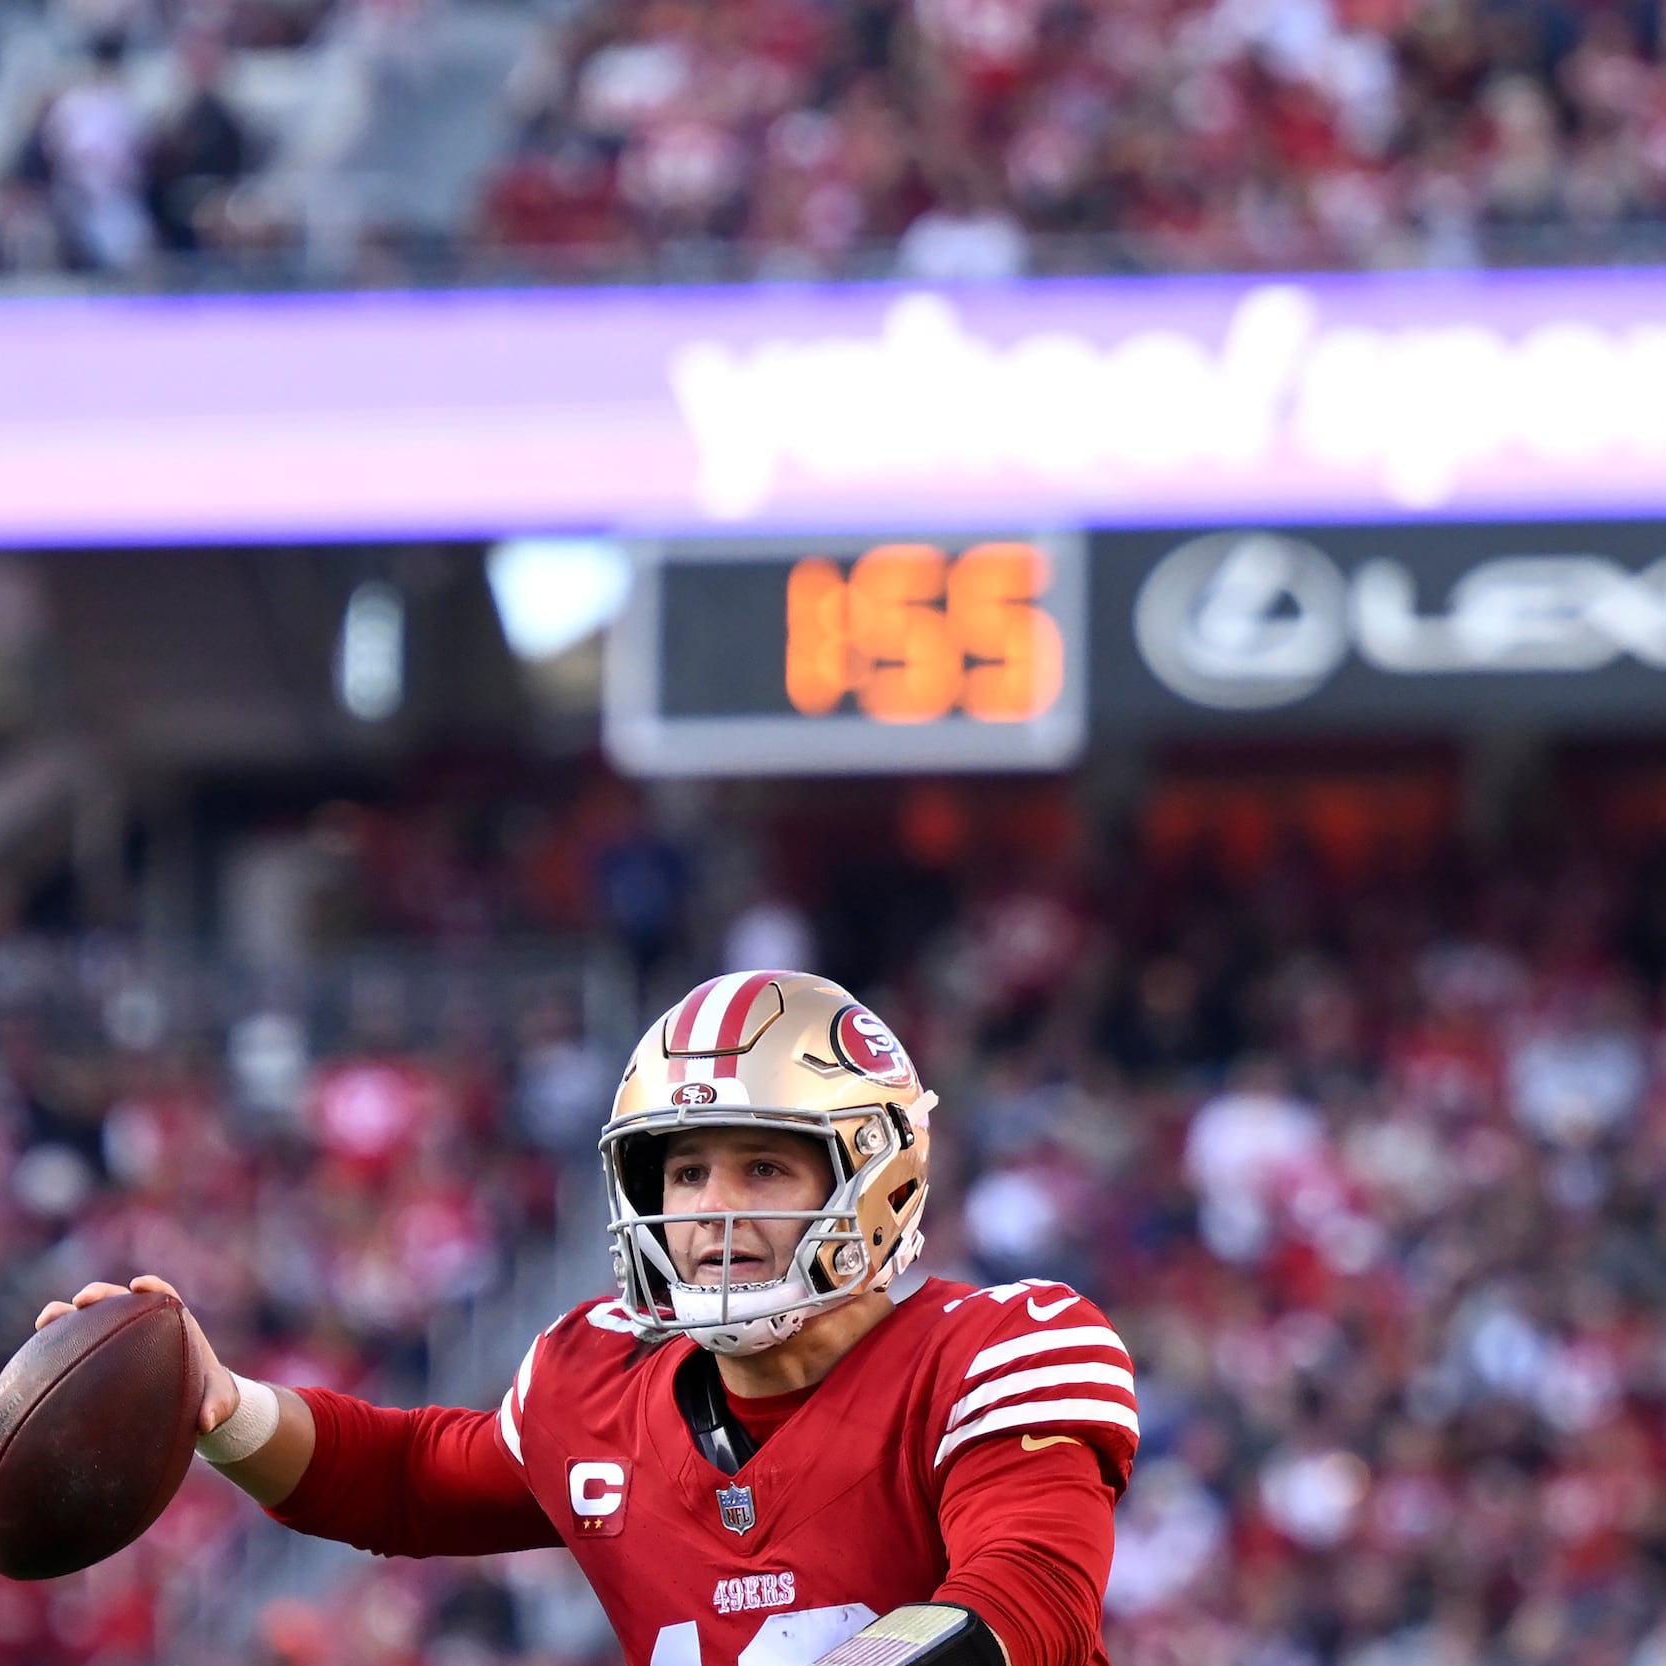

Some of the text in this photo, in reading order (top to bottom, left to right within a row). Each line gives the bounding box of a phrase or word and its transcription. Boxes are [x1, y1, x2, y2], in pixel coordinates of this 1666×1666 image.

[568, 1460, 625, 1516] C
[725, 1505, 750, 1525] NFL
[713, 1571, 796, 1614] 49ERS
